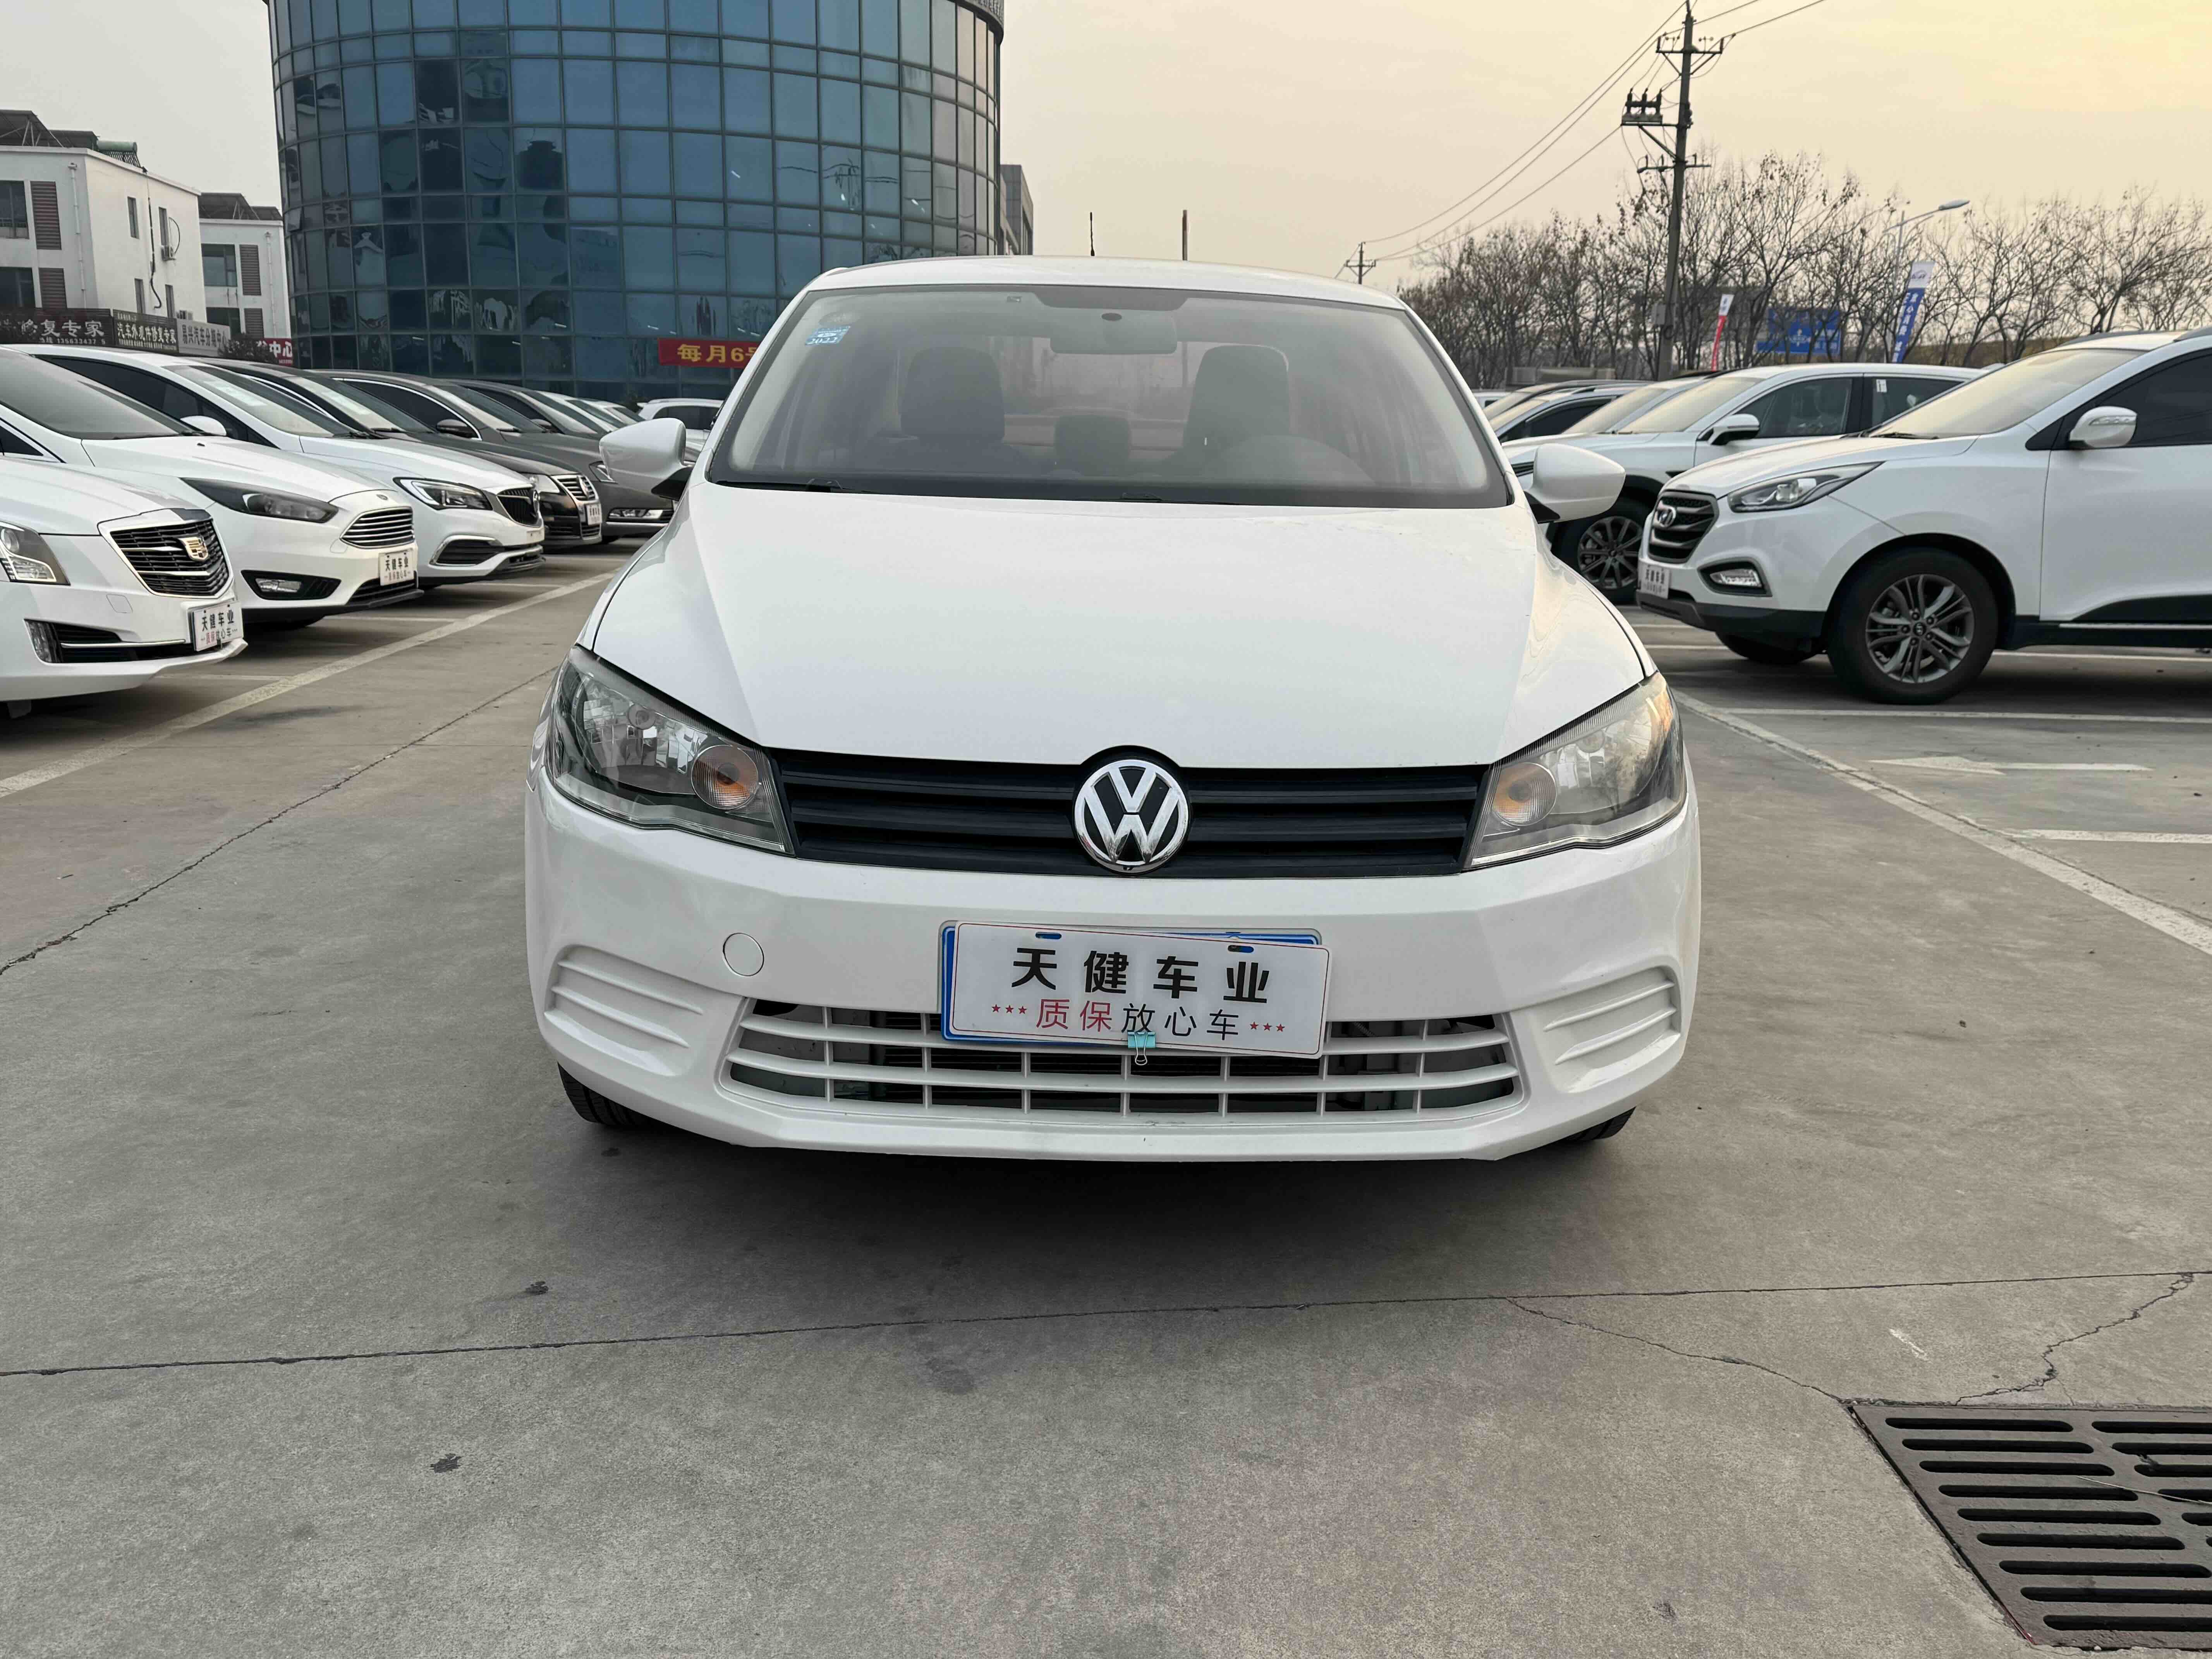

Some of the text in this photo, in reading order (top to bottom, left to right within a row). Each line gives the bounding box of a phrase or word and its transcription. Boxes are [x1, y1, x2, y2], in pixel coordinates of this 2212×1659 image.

[1011, 947, 1270, 1003] 天健车业
[1036, 999, 1239, 1041] 质保放心车
